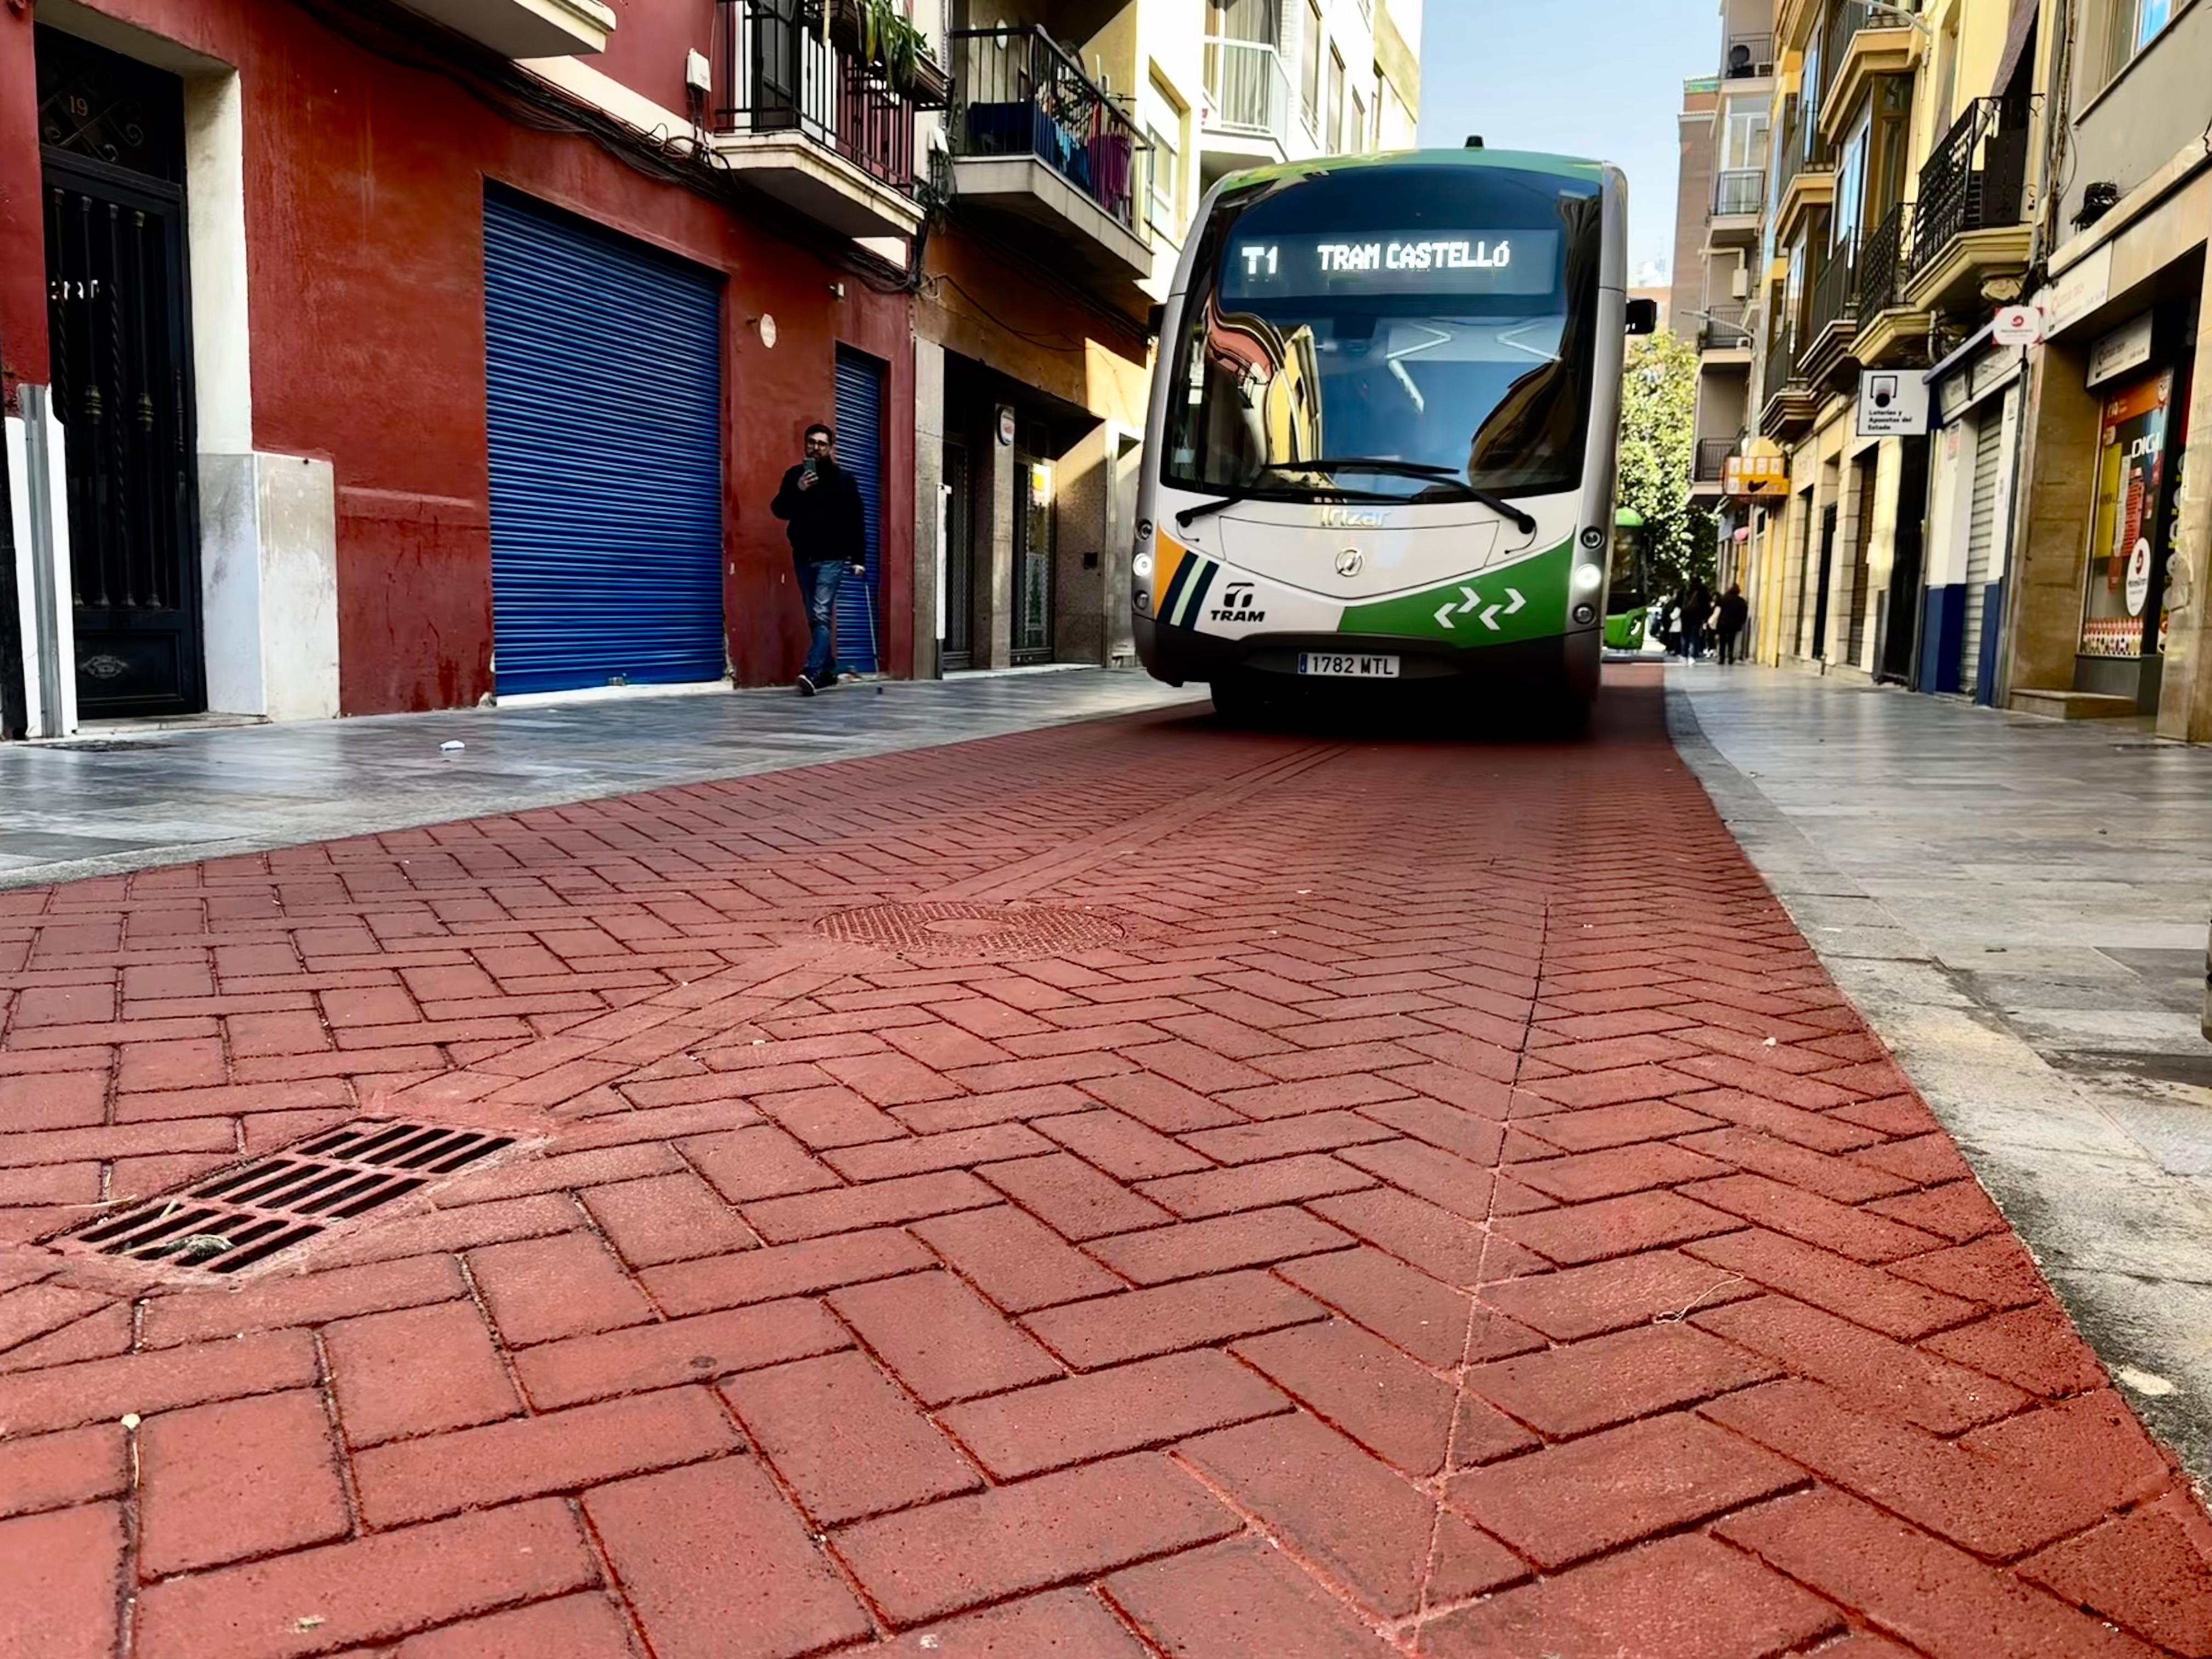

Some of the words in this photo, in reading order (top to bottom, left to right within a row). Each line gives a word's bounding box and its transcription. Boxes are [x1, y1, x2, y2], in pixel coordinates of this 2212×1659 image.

[70, 95, 88, 116] 19
[1242, 246, 1278, 274] T1
[1317, 243, 1380, 270] TRAM
[1386, 240, 1510, 269] CASTELLÓ
[1211, 610, 1265, 622] TRAM
[1313, 657, 1354, 673] 1782
[1361, 657, 1393, 674] MTL
